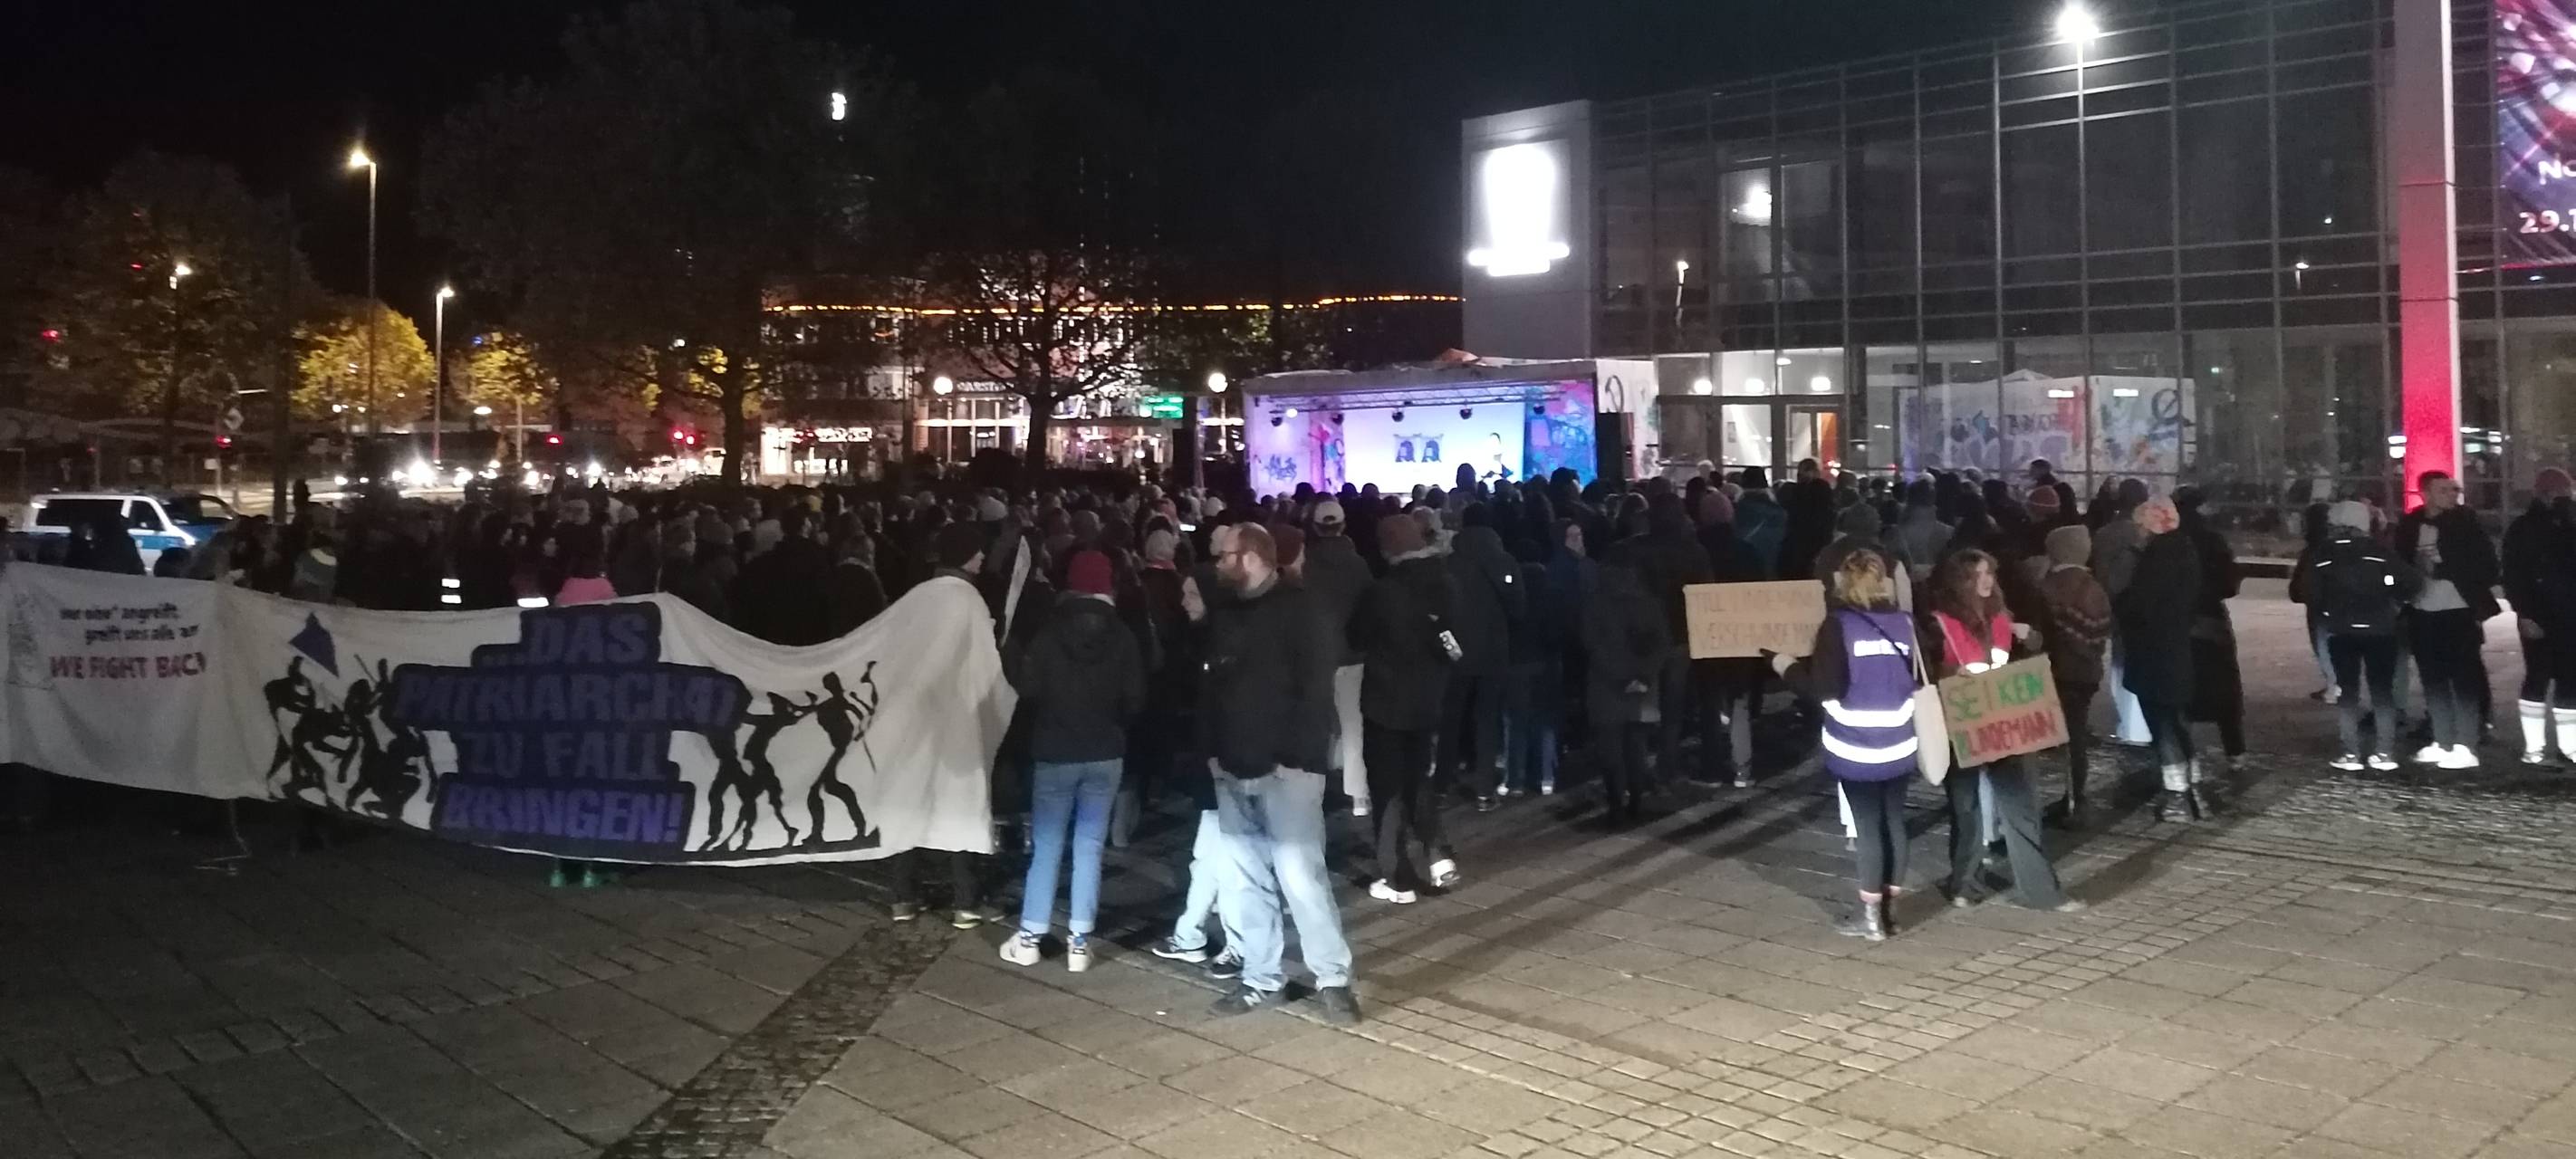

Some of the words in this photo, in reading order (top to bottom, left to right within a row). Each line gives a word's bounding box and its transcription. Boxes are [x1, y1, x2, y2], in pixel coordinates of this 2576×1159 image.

[49, 656, 84, 679] WE
[89, 656, 149, 679] FIGHT
[395, 672, 738, 727] PATRIARCHAT
[462, 732, 524, 779] ZU
[543, 731, 666, 781] FALL
[440, 783, 686, 844] BRINGEN!
